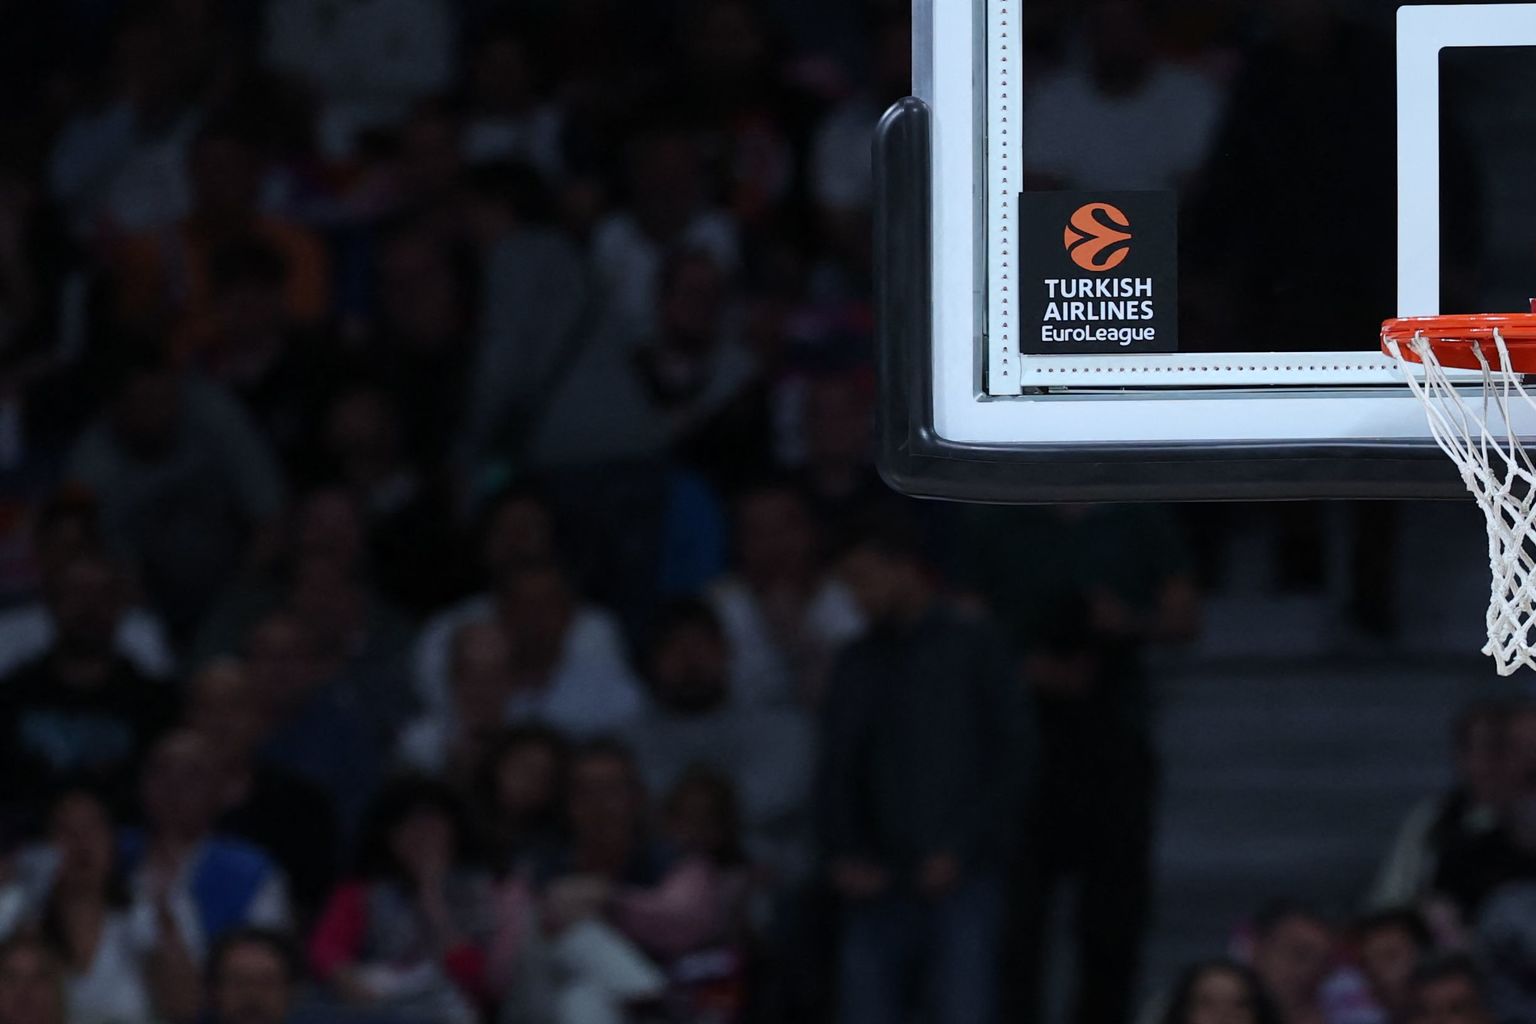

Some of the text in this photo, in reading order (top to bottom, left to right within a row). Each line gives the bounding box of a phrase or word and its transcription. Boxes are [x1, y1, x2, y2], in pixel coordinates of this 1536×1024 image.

[1044, 277, 1153, 298] TURKISH
[1043, 300, 1154, 321] AIRLINES
[1041, 324, 1156, 346] EuroLeague
